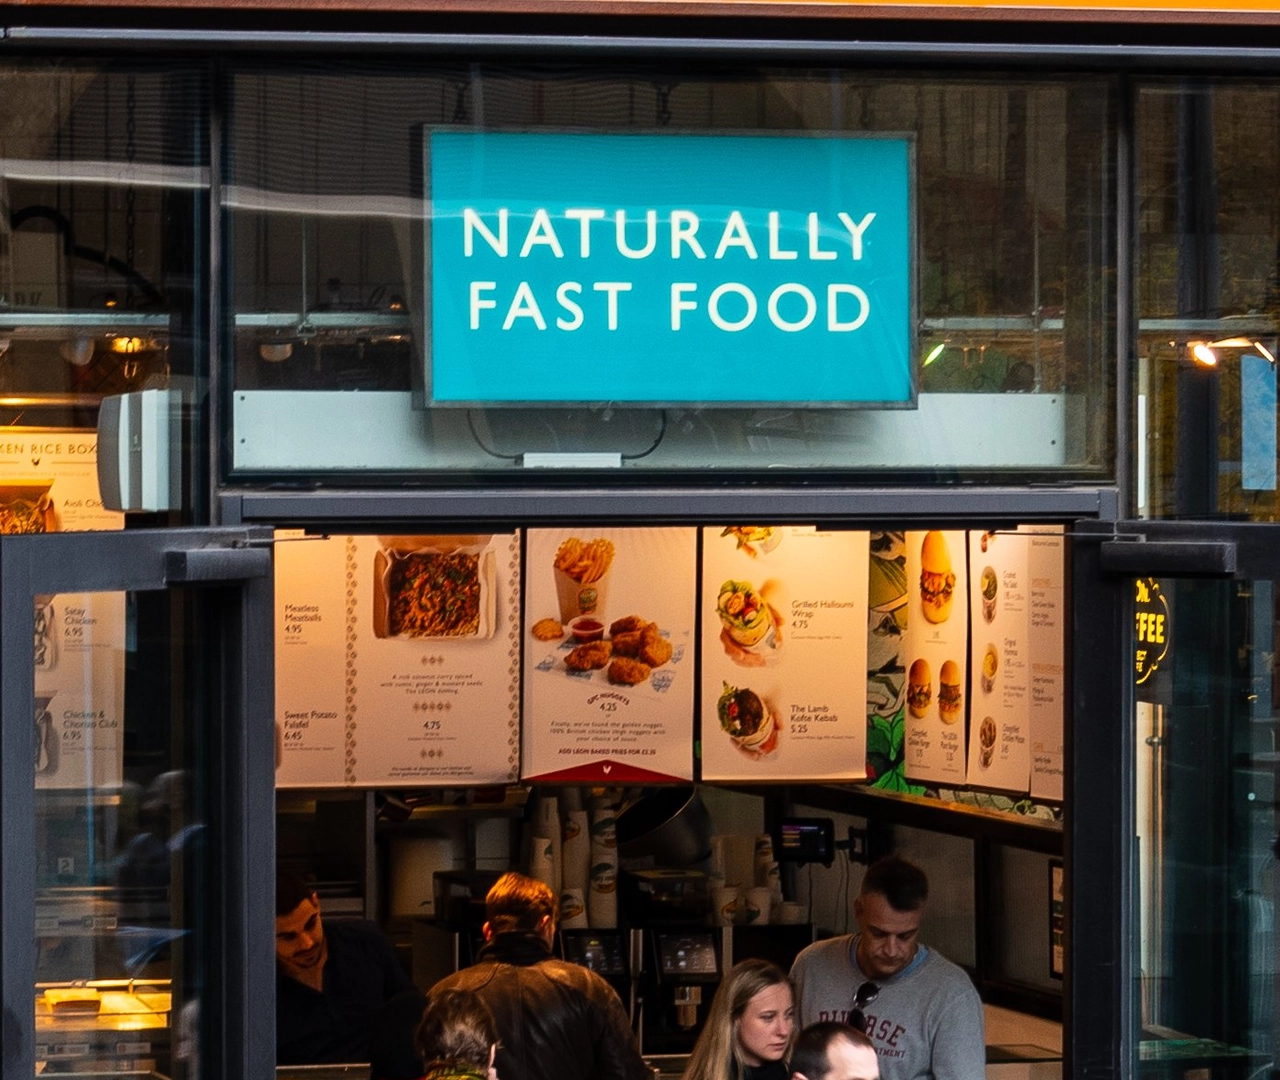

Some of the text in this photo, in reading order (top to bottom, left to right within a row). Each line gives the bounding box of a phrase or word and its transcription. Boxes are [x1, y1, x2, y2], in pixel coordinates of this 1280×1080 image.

[463, 207, 877, 261] NATURALLY
[469, 280, 871, 333] FAST FOOD
[30, 443, 62, 455] RICE
[791, 600, 854, 609] Grilled Halloumi
[284, 613, 322, 622] Meatballs
[791, 610, 814, 619] Wrap
[791, 704, 829, 713] The Lamb
[310, 710, 338, 720] Potato
